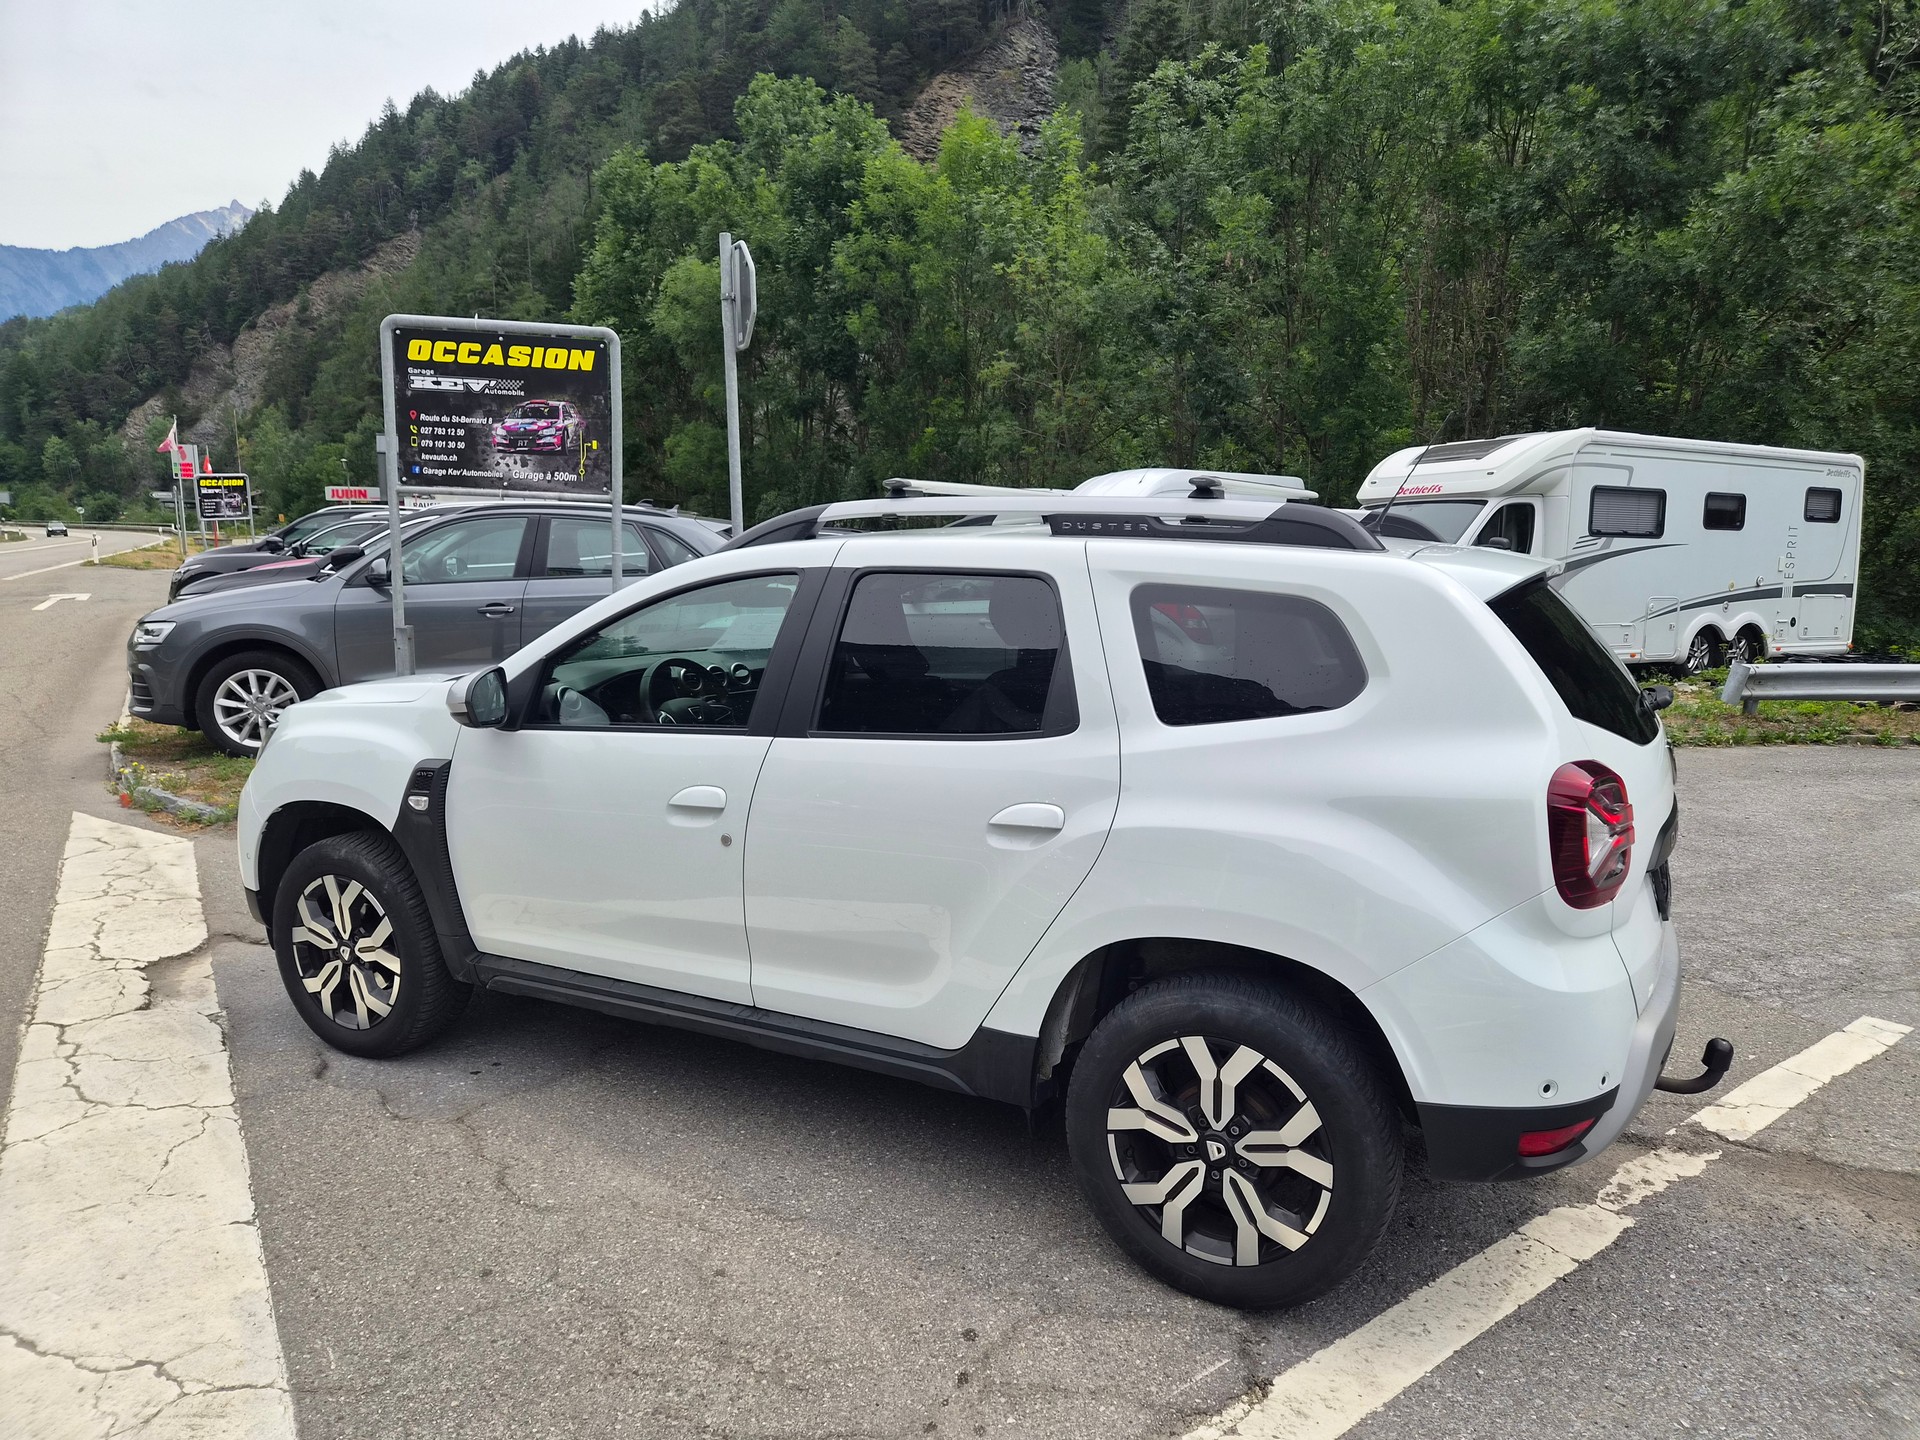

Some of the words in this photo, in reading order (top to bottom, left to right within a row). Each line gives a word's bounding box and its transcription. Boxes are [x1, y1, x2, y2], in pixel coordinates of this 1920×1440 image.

[407, 339, 595, 371] OCCASION
[407, 366, 435, 375] Garage
[420, 413, 440, 422] Route
[441, 414, 450, 422] du
[451, 415, 487, 424] St-Bernard
[434, 427, 445, 435] 783
[457, 428, 465, 436] 50
[434, 440, 446, 448] 101
[457, 441, 465, 449] 50
[421, 453, 457, 461] kevauto.ch
[422, 467, 447, 476] Garage
[512, 469, 544, 481] Garage
[546, 471, 551, 479] à
[553, 471, 577, 481] 500m
[199, 479, 244, 487] OCCASION
[331, 488, 368, 499] JUBIN
[1062, 522, 1149, 531] DUSTER
[1784, 525, 1798, 579] ESPRIT
